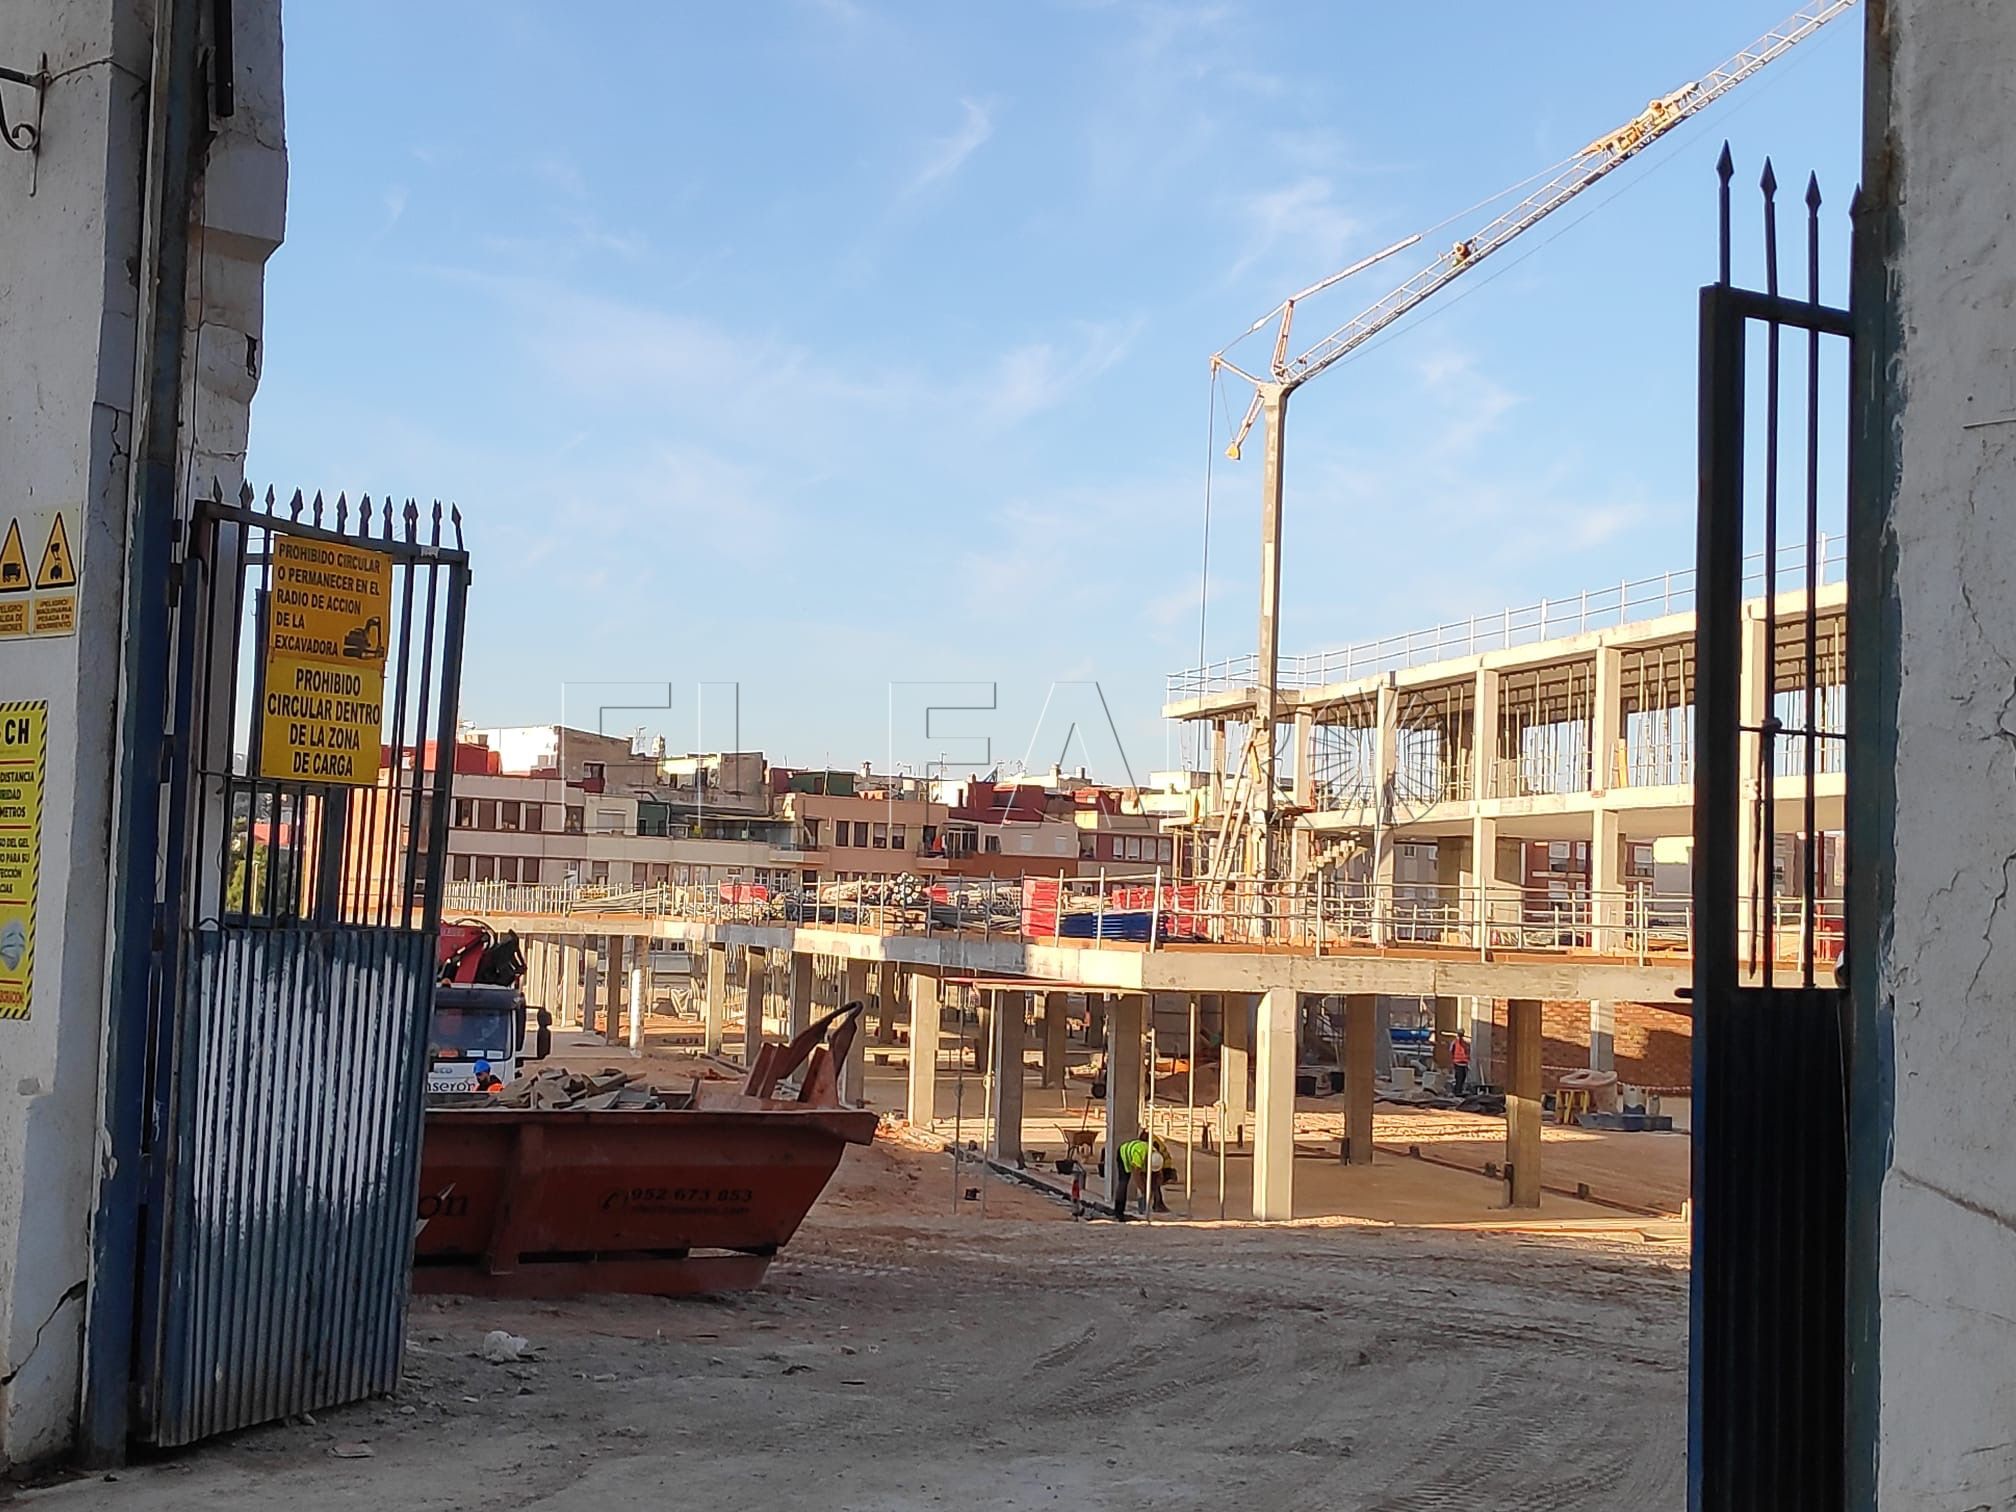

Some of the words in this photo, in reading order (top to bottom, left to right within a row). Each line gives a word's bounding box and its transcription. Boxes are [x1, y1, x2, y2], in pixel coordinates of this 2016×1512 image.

[279, 543, 335, 565] PROHIBIDO
[337, 553, 380, 574] CIRCULAR
[277, 566, 285, 580] O
[288, 567, 353, 590] PERMANECER
[355, 579, 367, 594] EN
[369, 581, 380, 595] EL
[276, 589, 309, 607] RADIO
[311, 594, 324, 609] DE
[326, 596, 361, 614] ACCION
[276, 612, 290, 627] DE
[292, 614, 305, 629] LA
[275, 634, 338, 656] EXCAVADORA
[296, 668, 361, 696] PROHIBIDO
[267, 693, 332, 720] CIRCULAR
[335, 701, 380, 725] DENTRO
[5, 718, 30, 745] CH
[289, 723, 306, 745] DE
[310, 725, 325, 747] LA
[328, 727, 360, 751] ZONA
[293, 752, 310, 773] DE
[313, 753, 353, 777] CARGA
